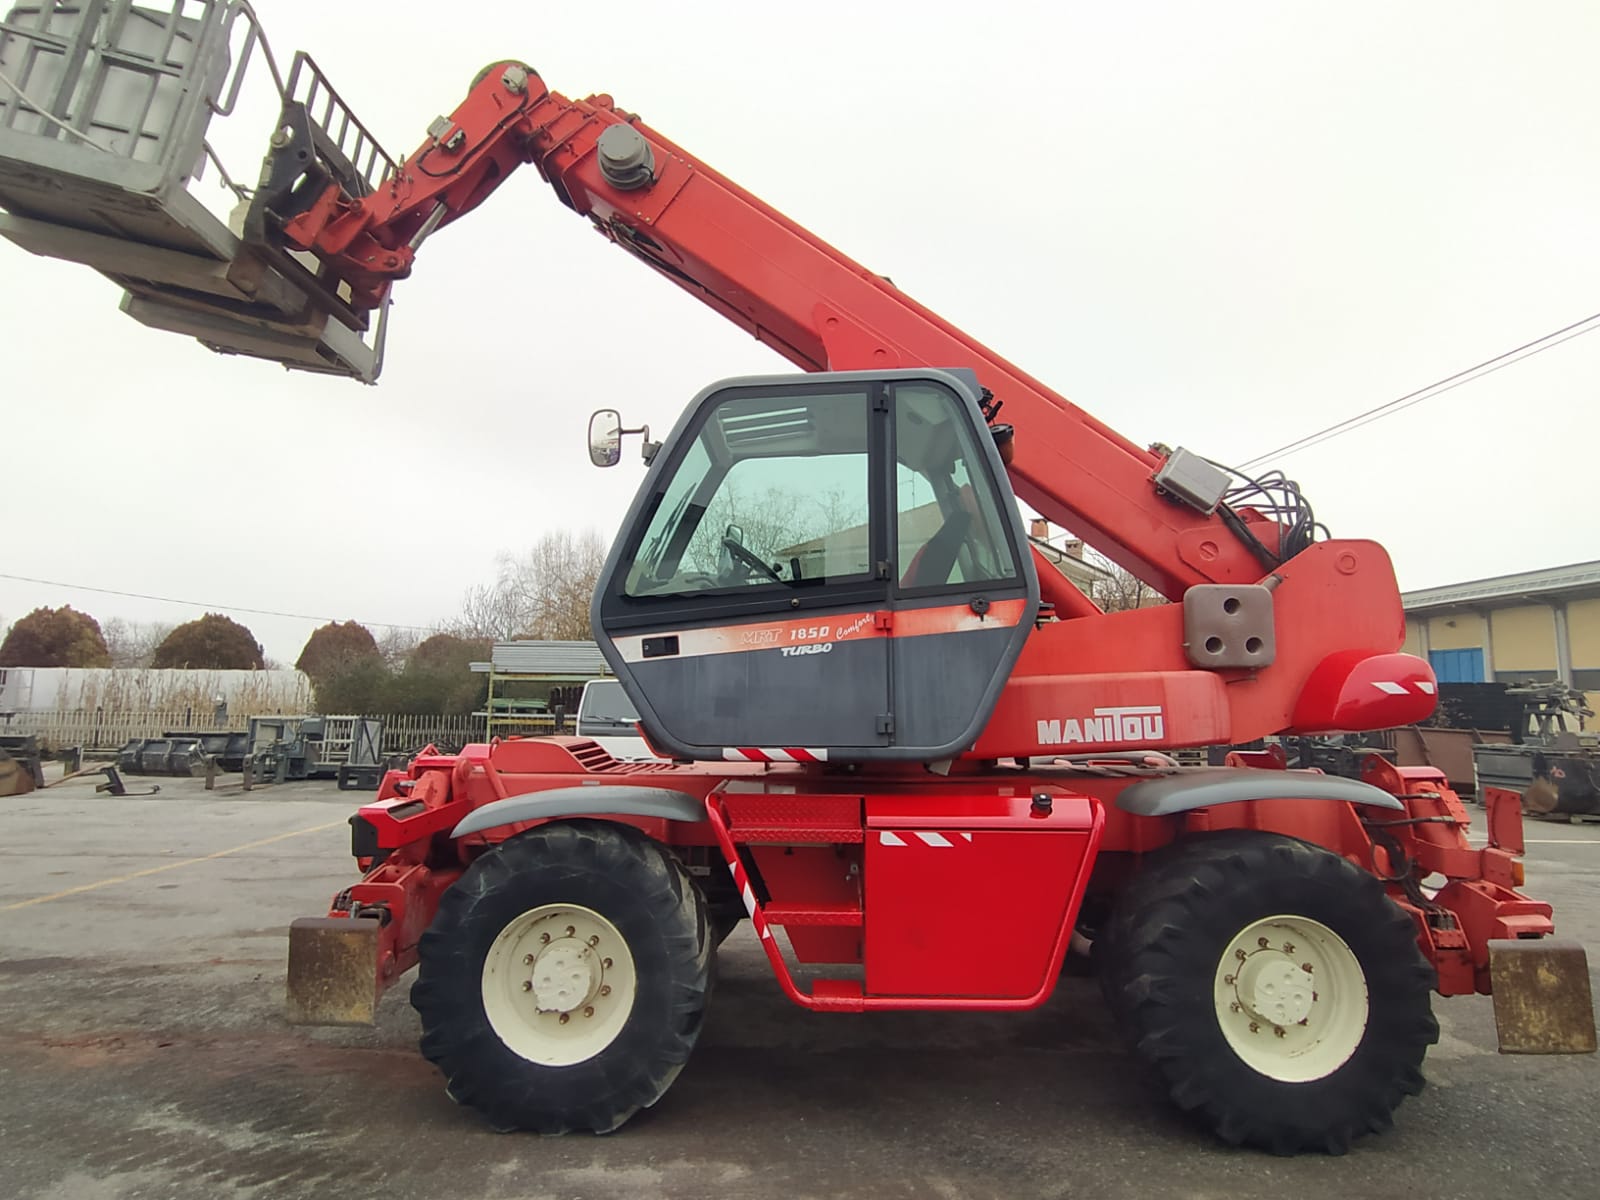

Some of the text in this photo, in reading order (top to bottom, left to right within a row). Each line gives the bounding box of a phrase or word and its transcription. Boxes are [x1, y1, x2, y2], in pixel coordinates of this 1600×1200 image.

[742, 628, 783, 644] MRT
[790, 626, 830, 640] 1850
[781, 643, 833, 657] TURBO
[1037, 706, 1164, 744] MANITOU
